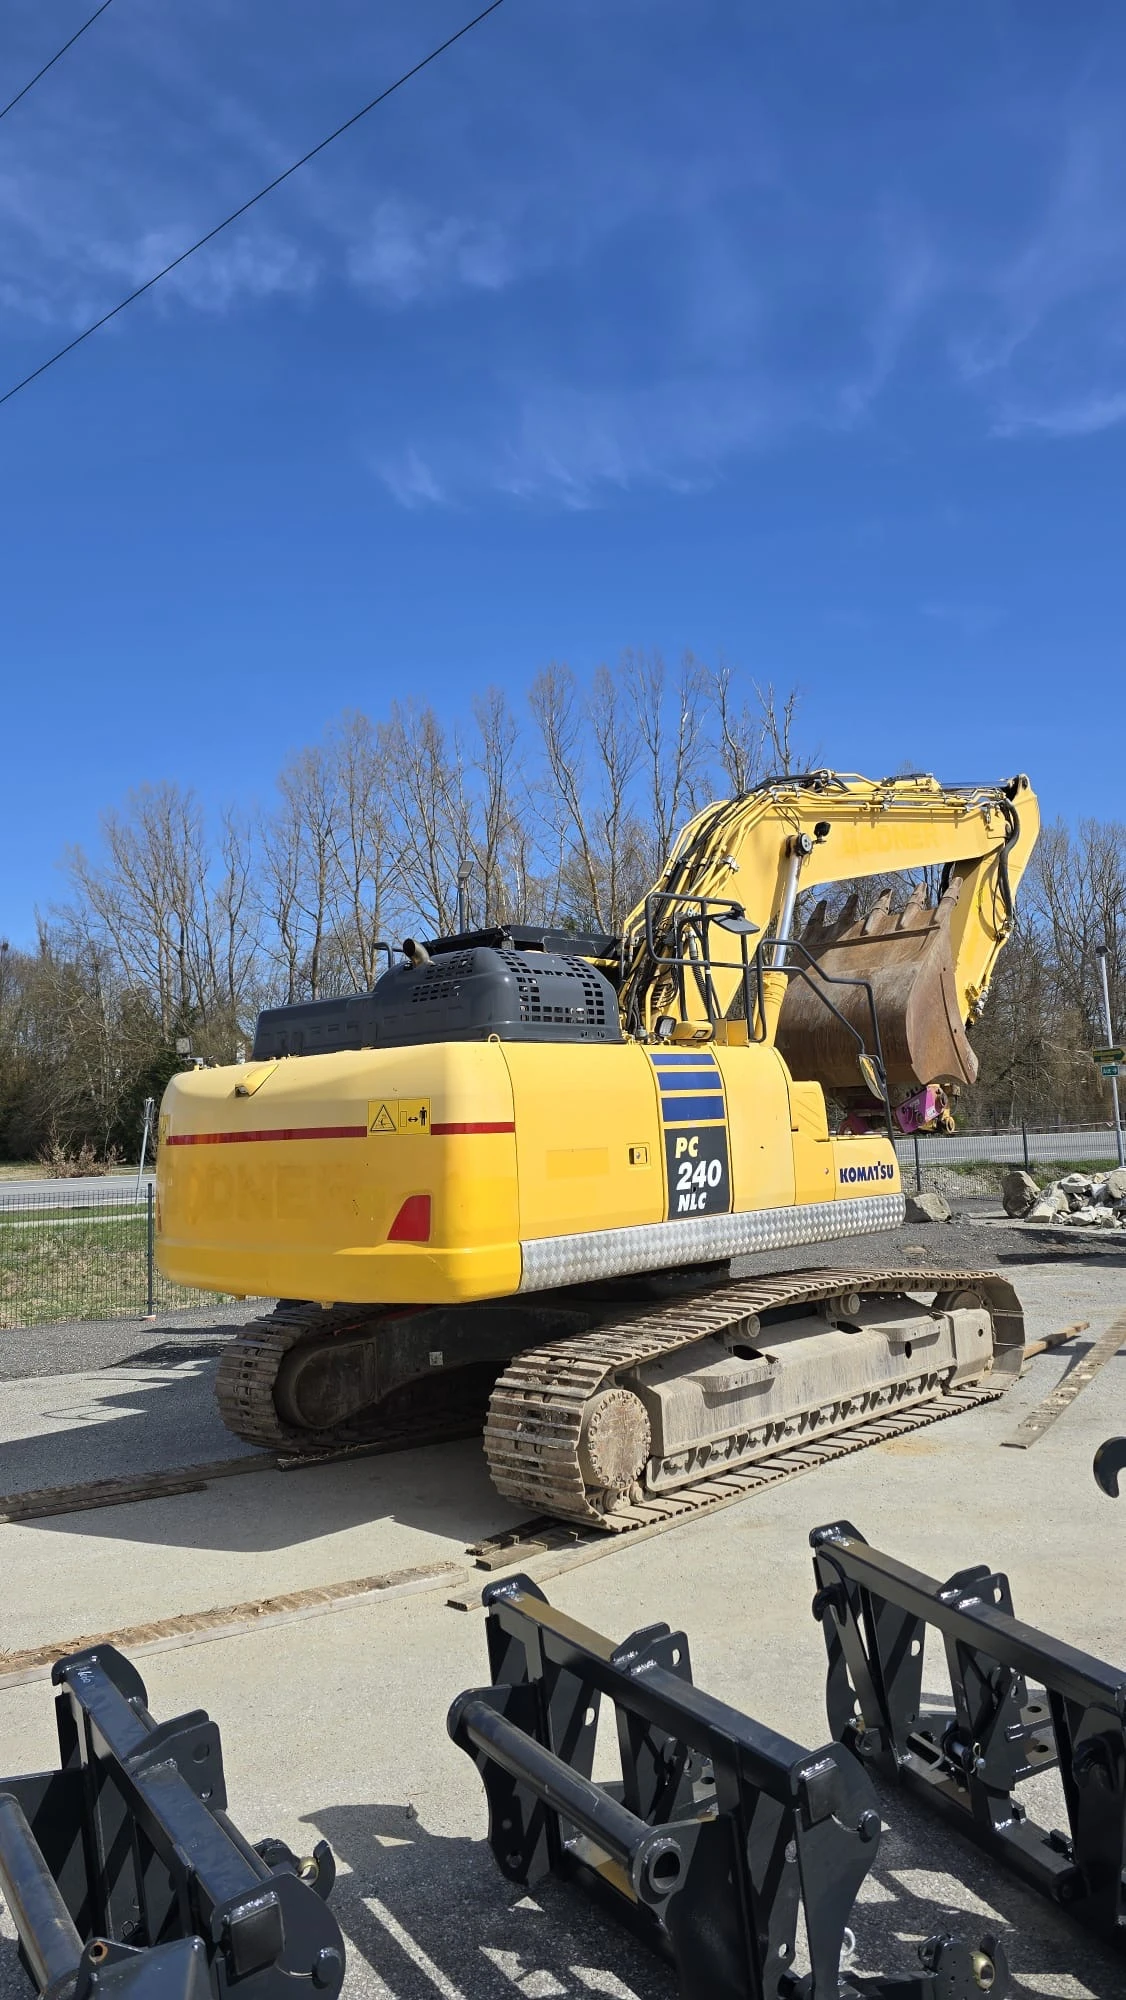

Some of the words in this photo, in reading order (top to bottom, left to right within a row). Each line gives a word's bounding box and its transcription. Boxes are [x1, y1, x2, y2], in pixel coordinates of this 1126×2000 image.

[675, 1136, 699, 1158] PC
[676, 1159, 722, 1190] 240
[840, 1161, 893, 1183] KOMATSU
[677, 1192, 707, 1212] NLC
